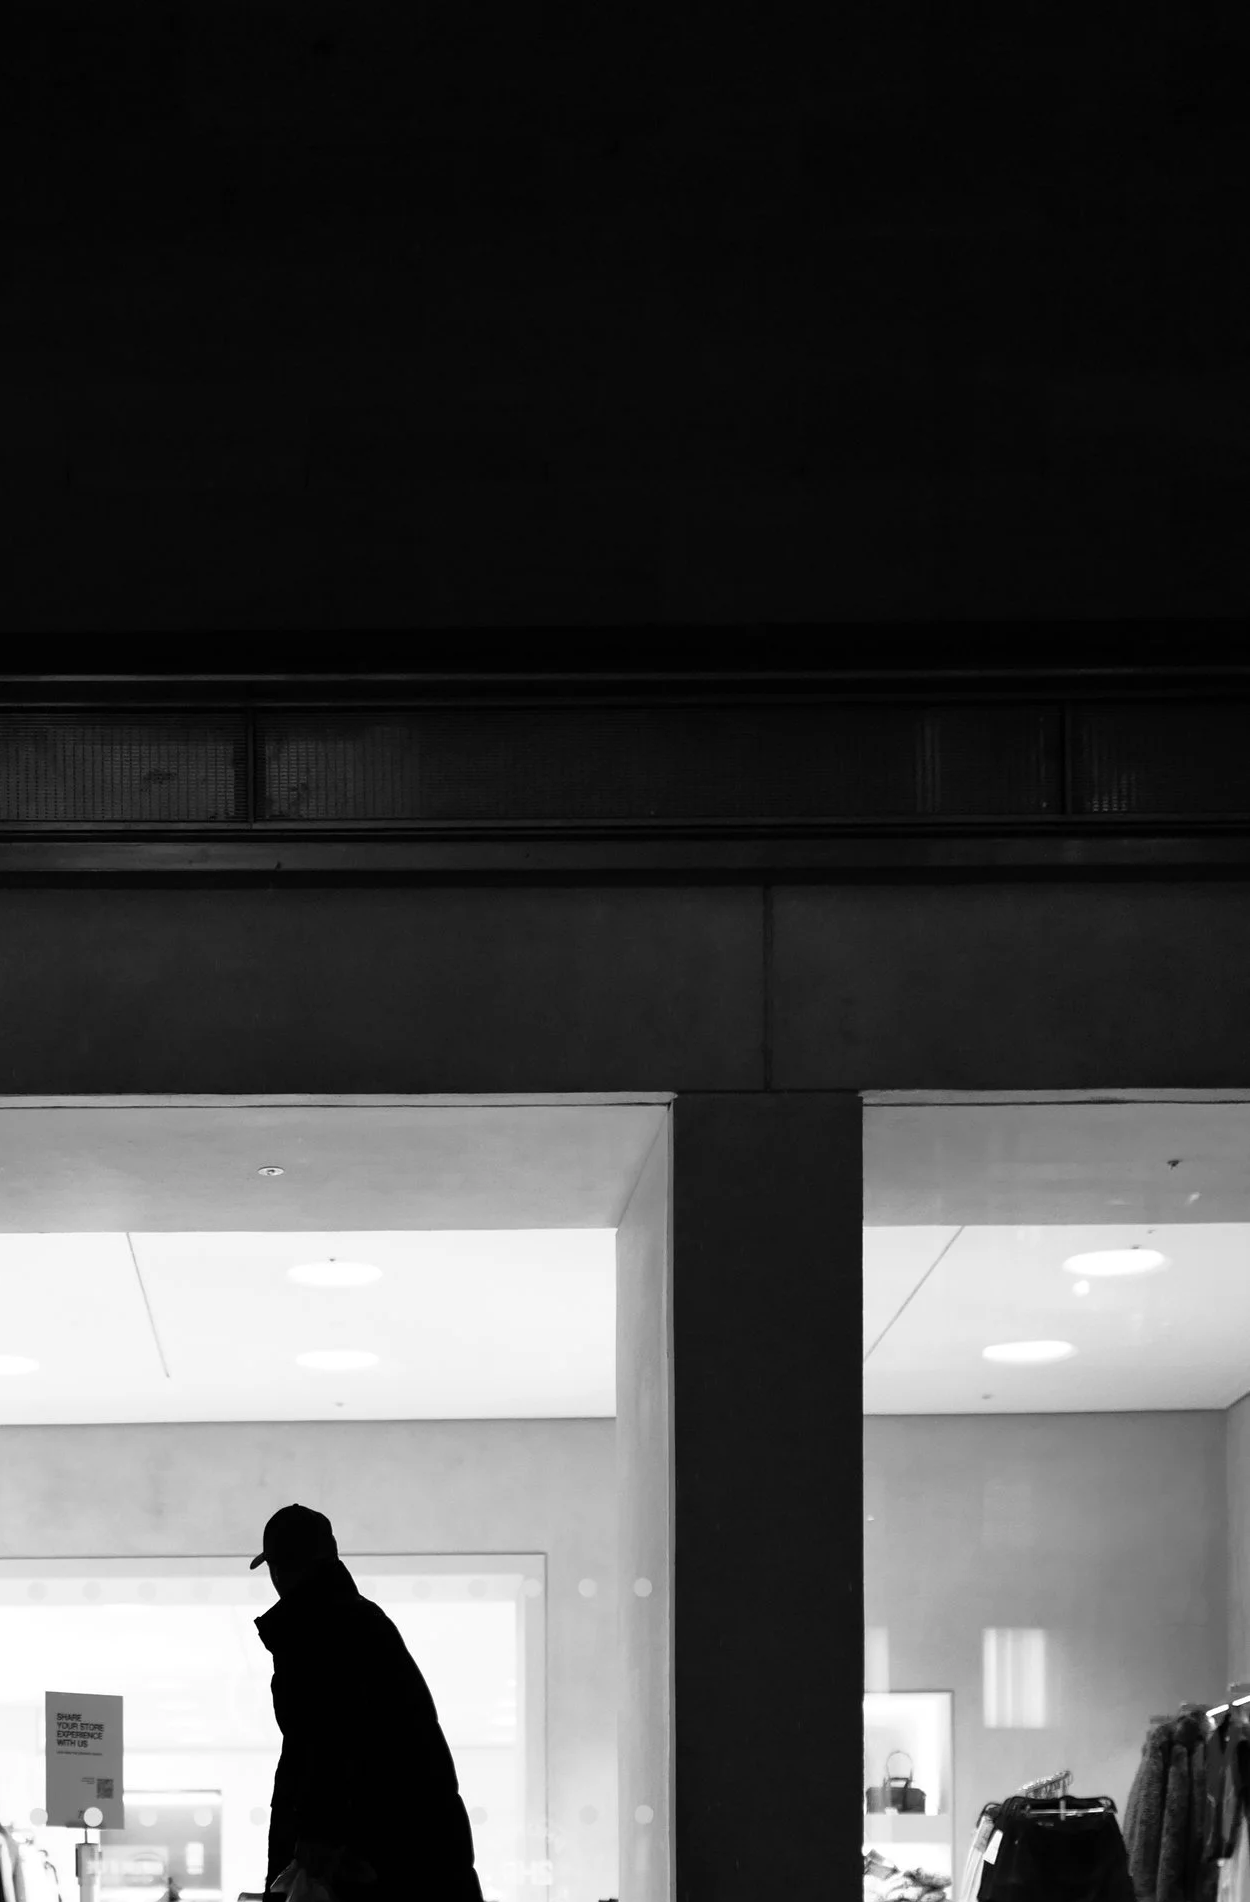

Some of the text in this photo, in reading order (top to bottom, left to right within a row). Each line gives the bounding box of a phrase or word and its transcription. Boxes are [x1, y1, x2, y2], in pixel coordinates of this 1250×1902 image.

[56, 1713, 82, 1721] SHARE
[57, 1722, 104, 1731] YOUR STORE
[57, 1730, 103, 1740] EXPERIENCE
[57, 1739, 88, 1748] WITH US
